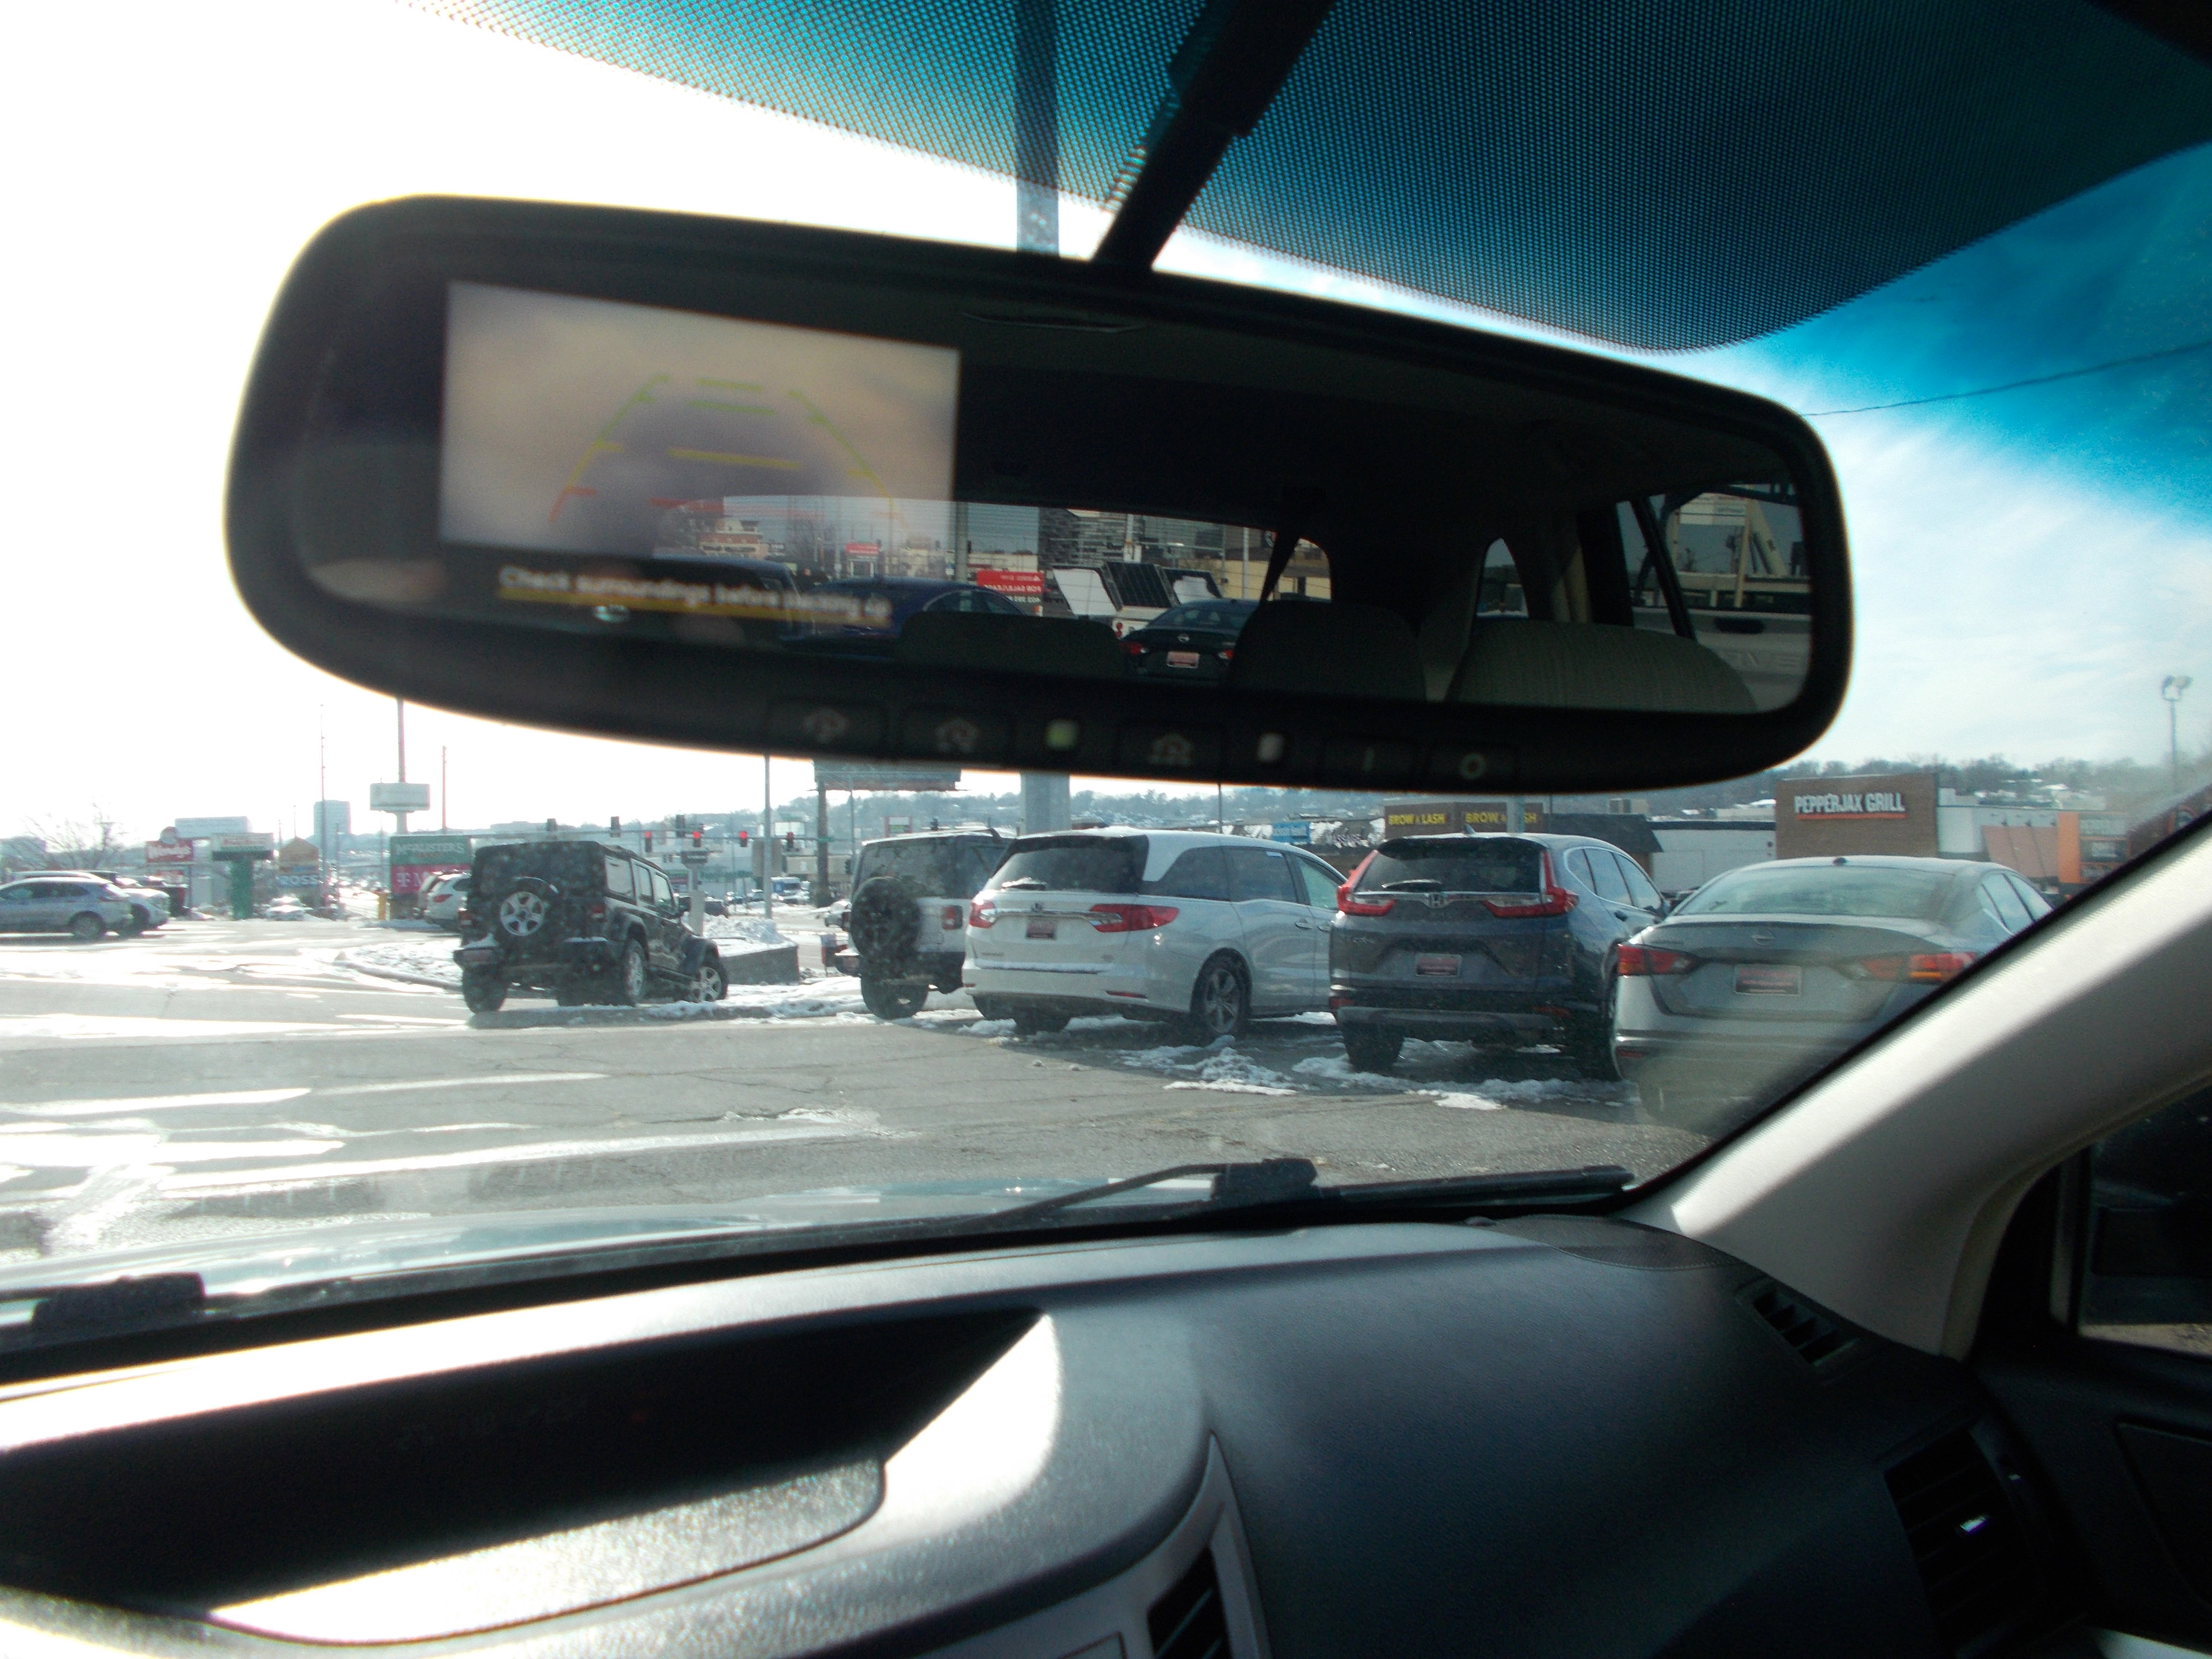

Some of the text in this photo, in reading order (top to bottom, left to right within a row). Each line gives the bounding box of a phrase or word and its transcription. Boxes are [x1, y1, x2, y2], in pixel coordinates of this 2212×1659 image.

[1794, 792, 1906, 813] PEPPERJAX GRILL
[1388, 814, 1414, 825] BROW
[1422, 813, 1445, 824] LASH
[1466, 812, 1498, 823] BROW
